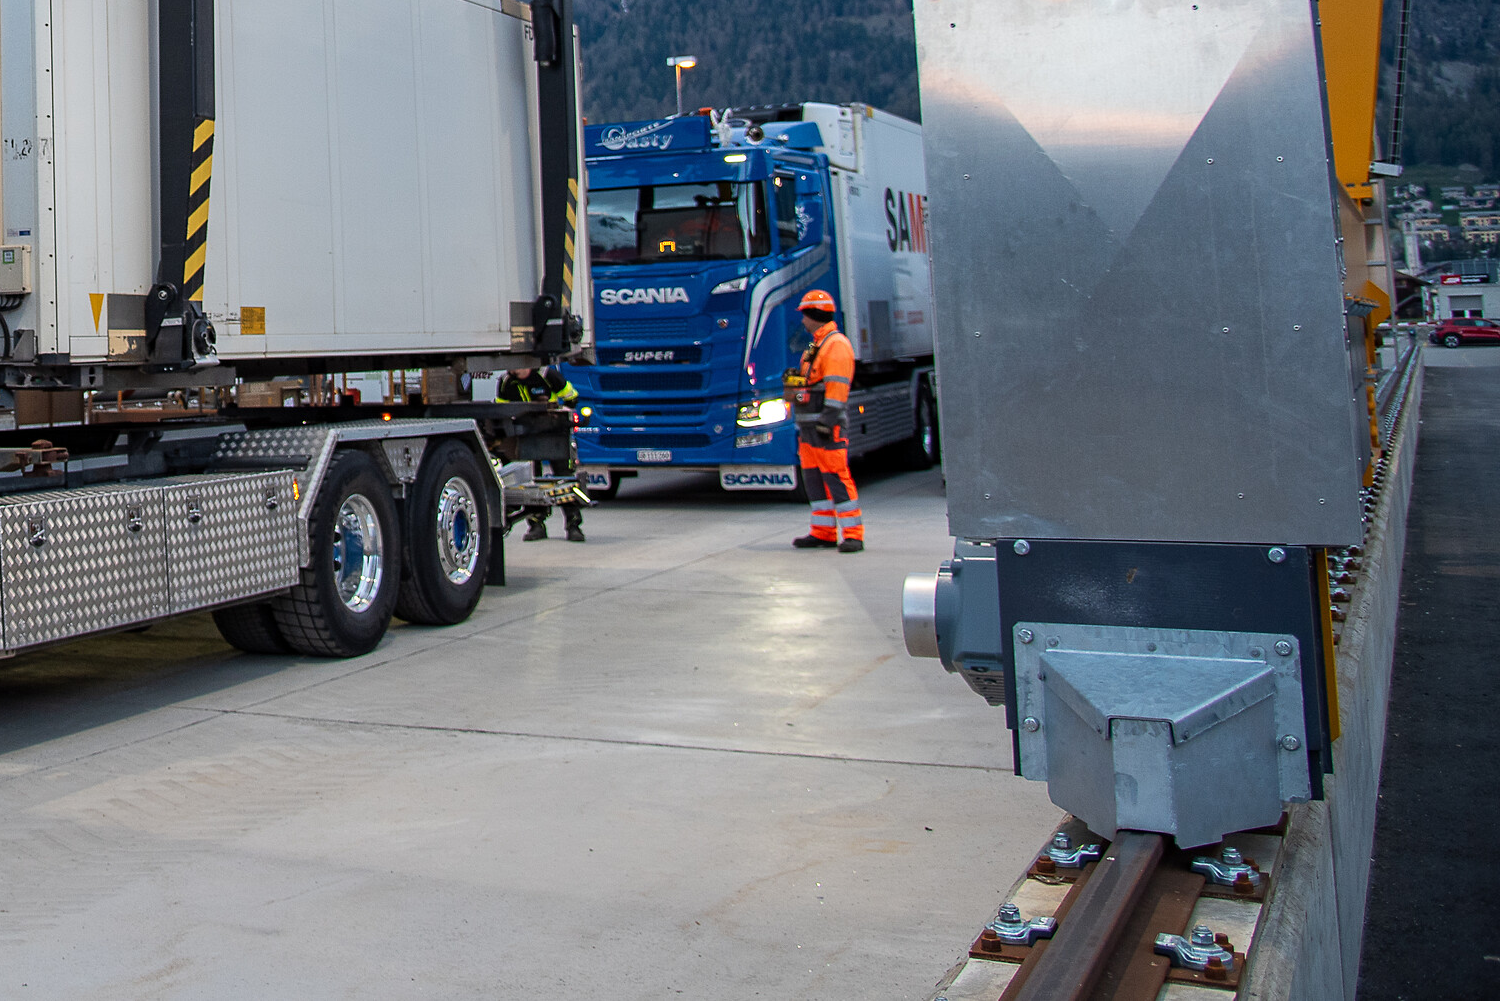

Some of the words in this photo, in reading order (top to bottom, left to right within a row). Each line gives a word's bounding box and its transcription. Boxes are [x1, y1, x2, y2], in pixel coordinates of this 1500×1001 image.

[600, 286, 690, 305] SCANIA
[624, 350, 676, 362] SUPER
[723, 473, 793, 485] SCANIA
